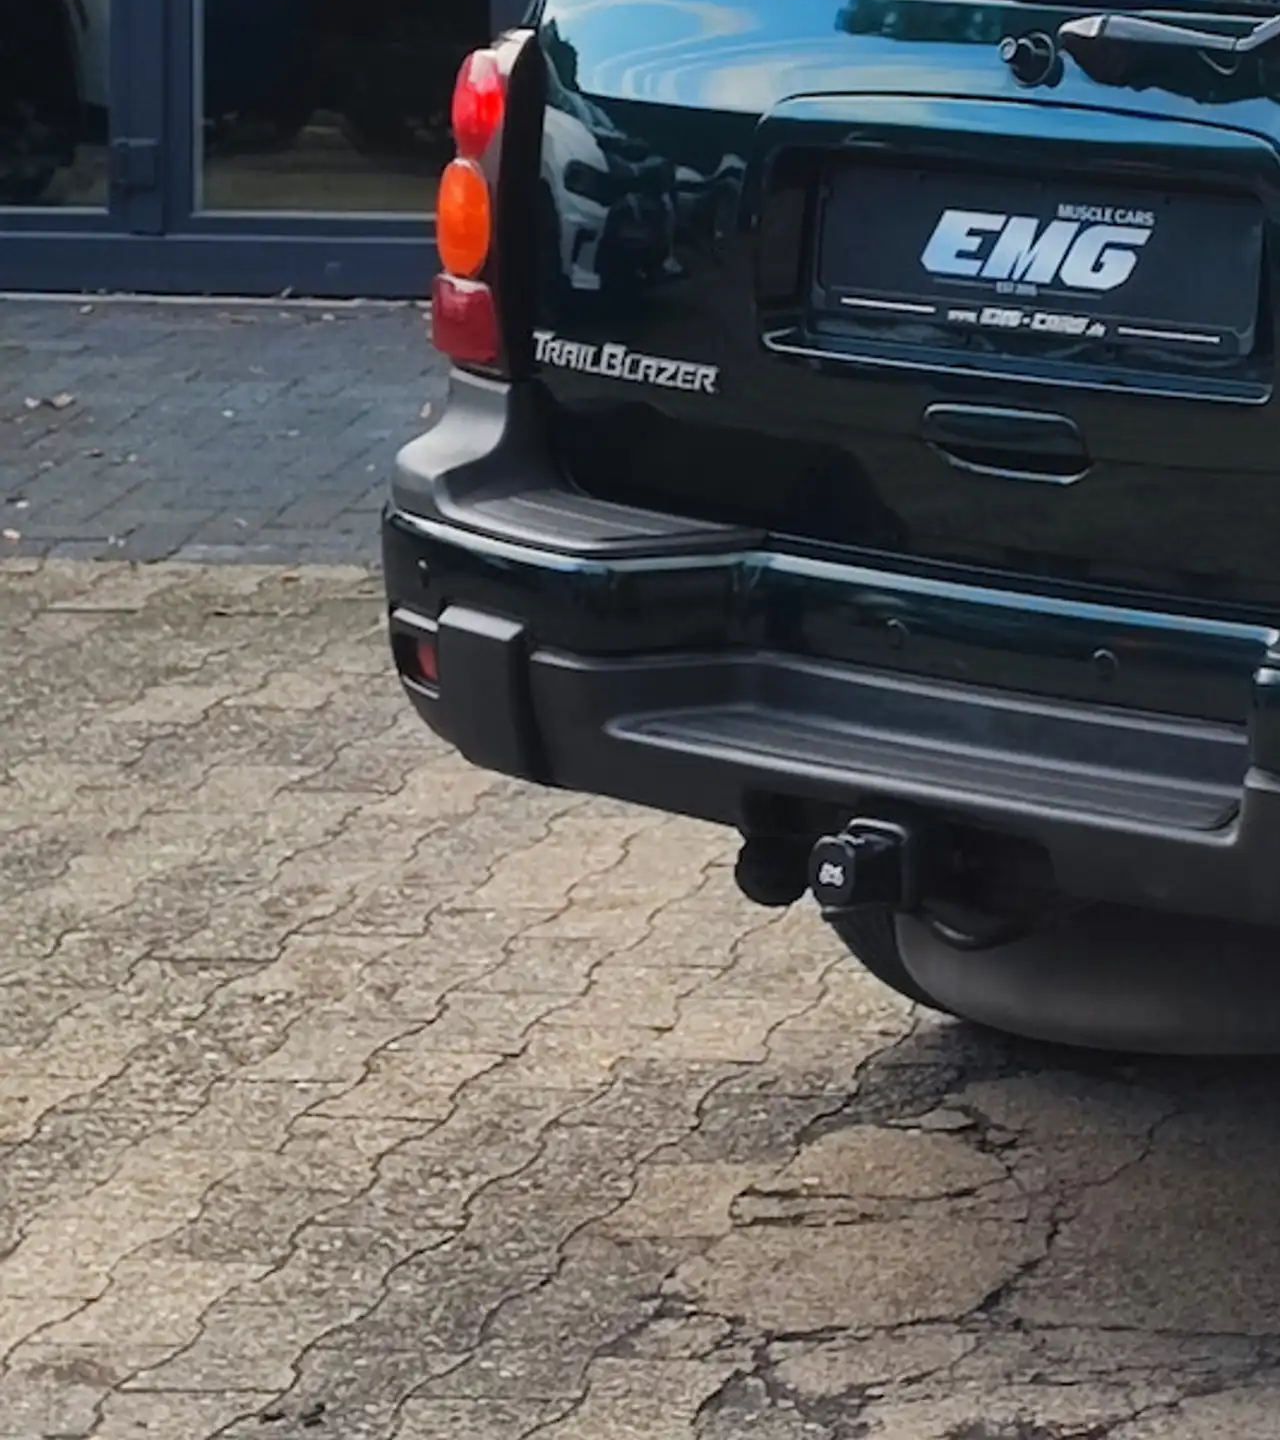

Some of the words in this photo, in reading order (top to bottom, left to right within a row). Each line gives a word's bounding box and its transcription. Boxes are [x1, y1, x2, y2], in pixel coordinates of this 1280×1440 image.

[1057, 203, 1114, 224] MUSCLE
[1114, 208, 1155, 227] CARS
[920, 209, 1153, 292] EMG
